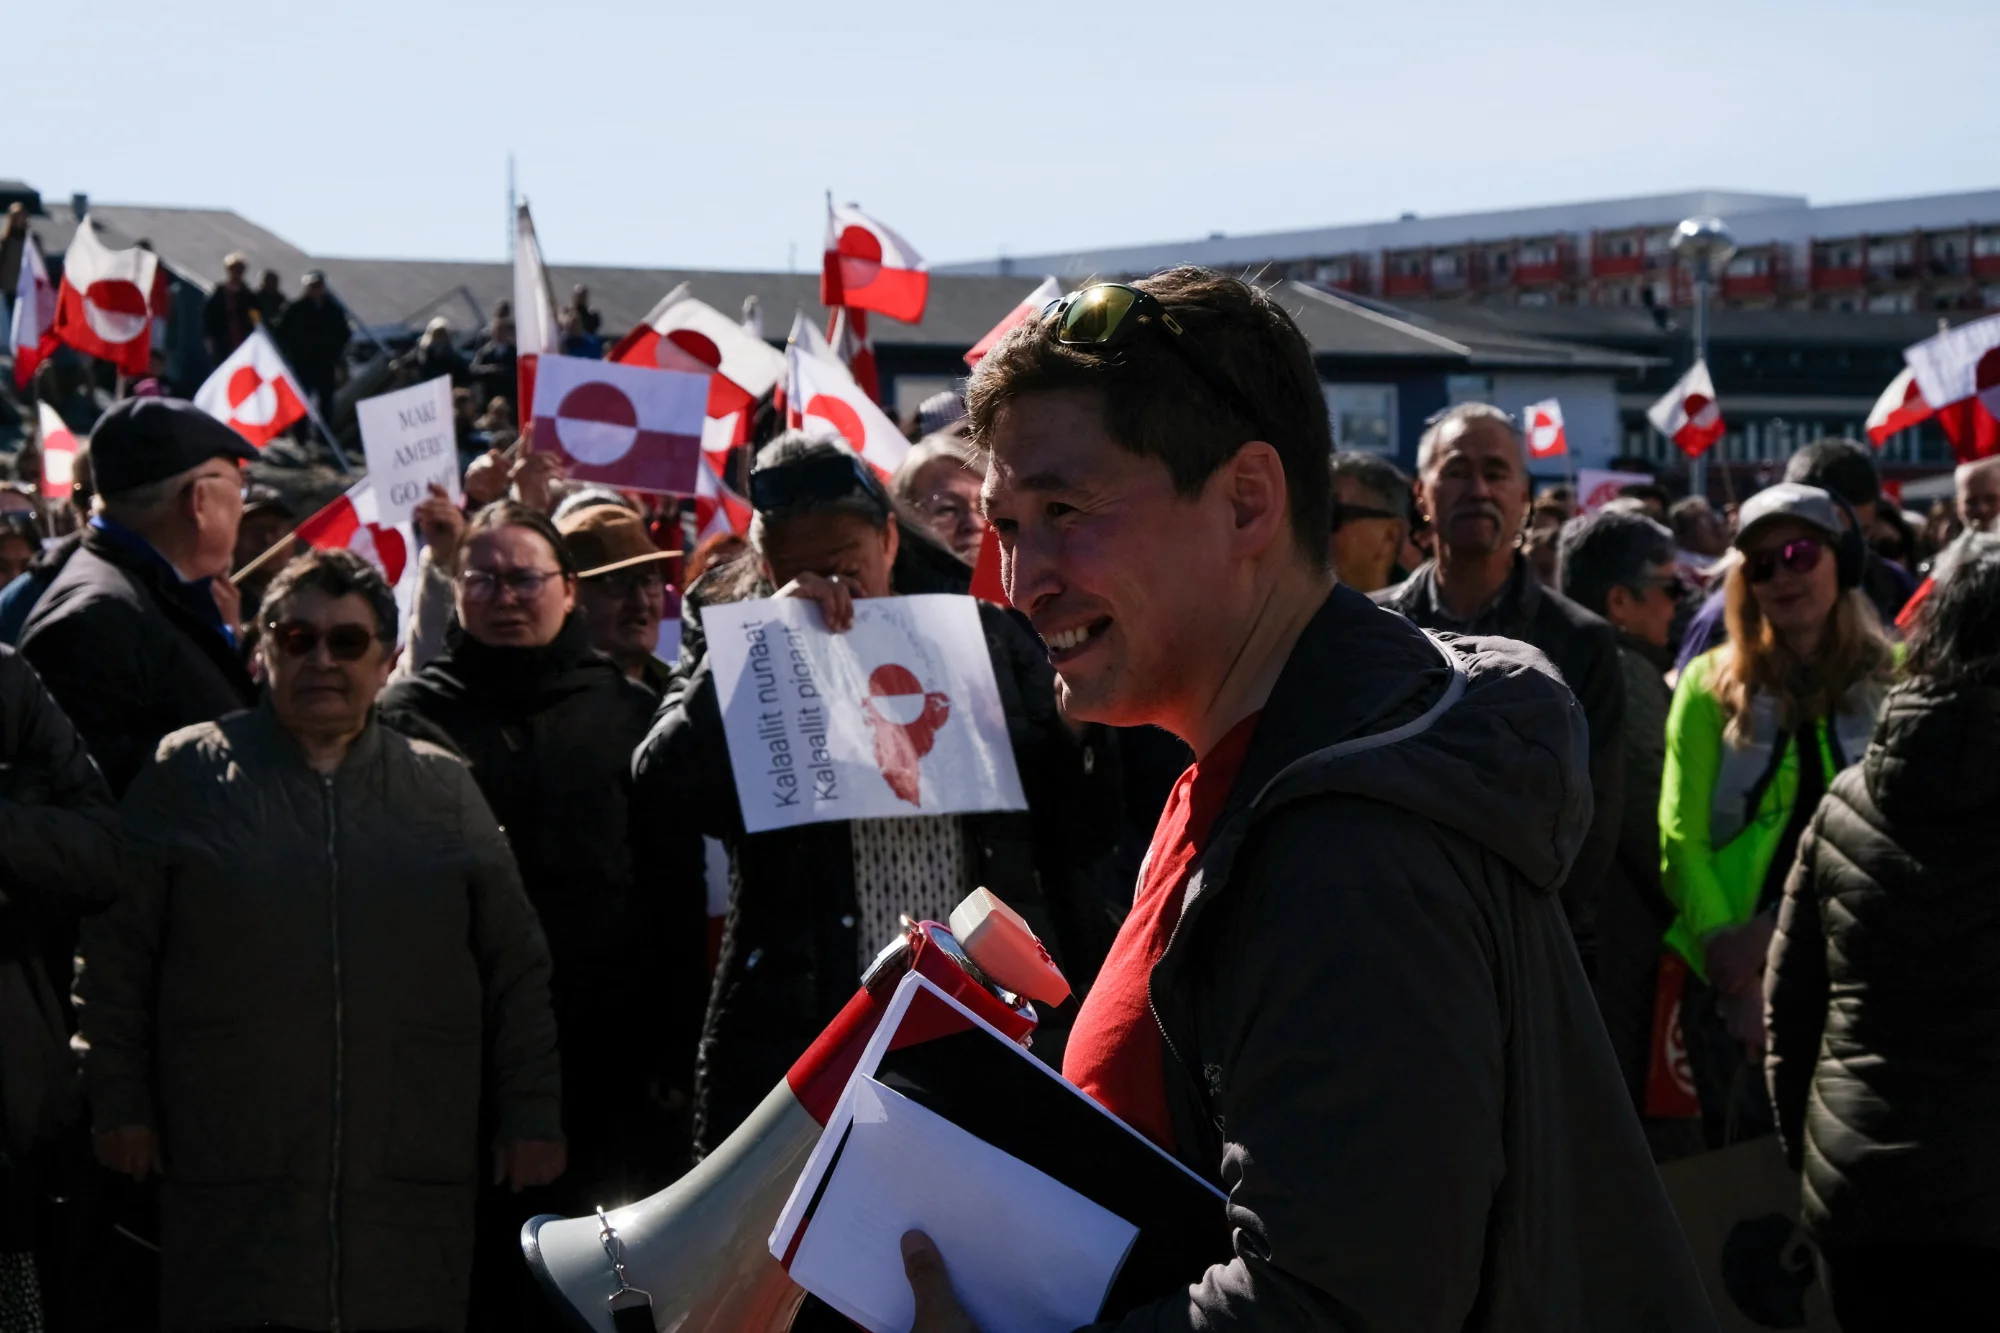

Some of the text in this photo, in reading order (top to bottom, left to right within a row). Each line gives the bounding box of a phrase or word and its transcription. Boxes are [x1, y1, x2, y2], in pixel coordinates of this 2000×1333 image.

[398, 399, 436, 430] MAKE
[390, 479, 420, 506] GO
[740, 620, 800, 808] Kalaallit nunaat
[797, 706, 839, 801] Kalaallit
